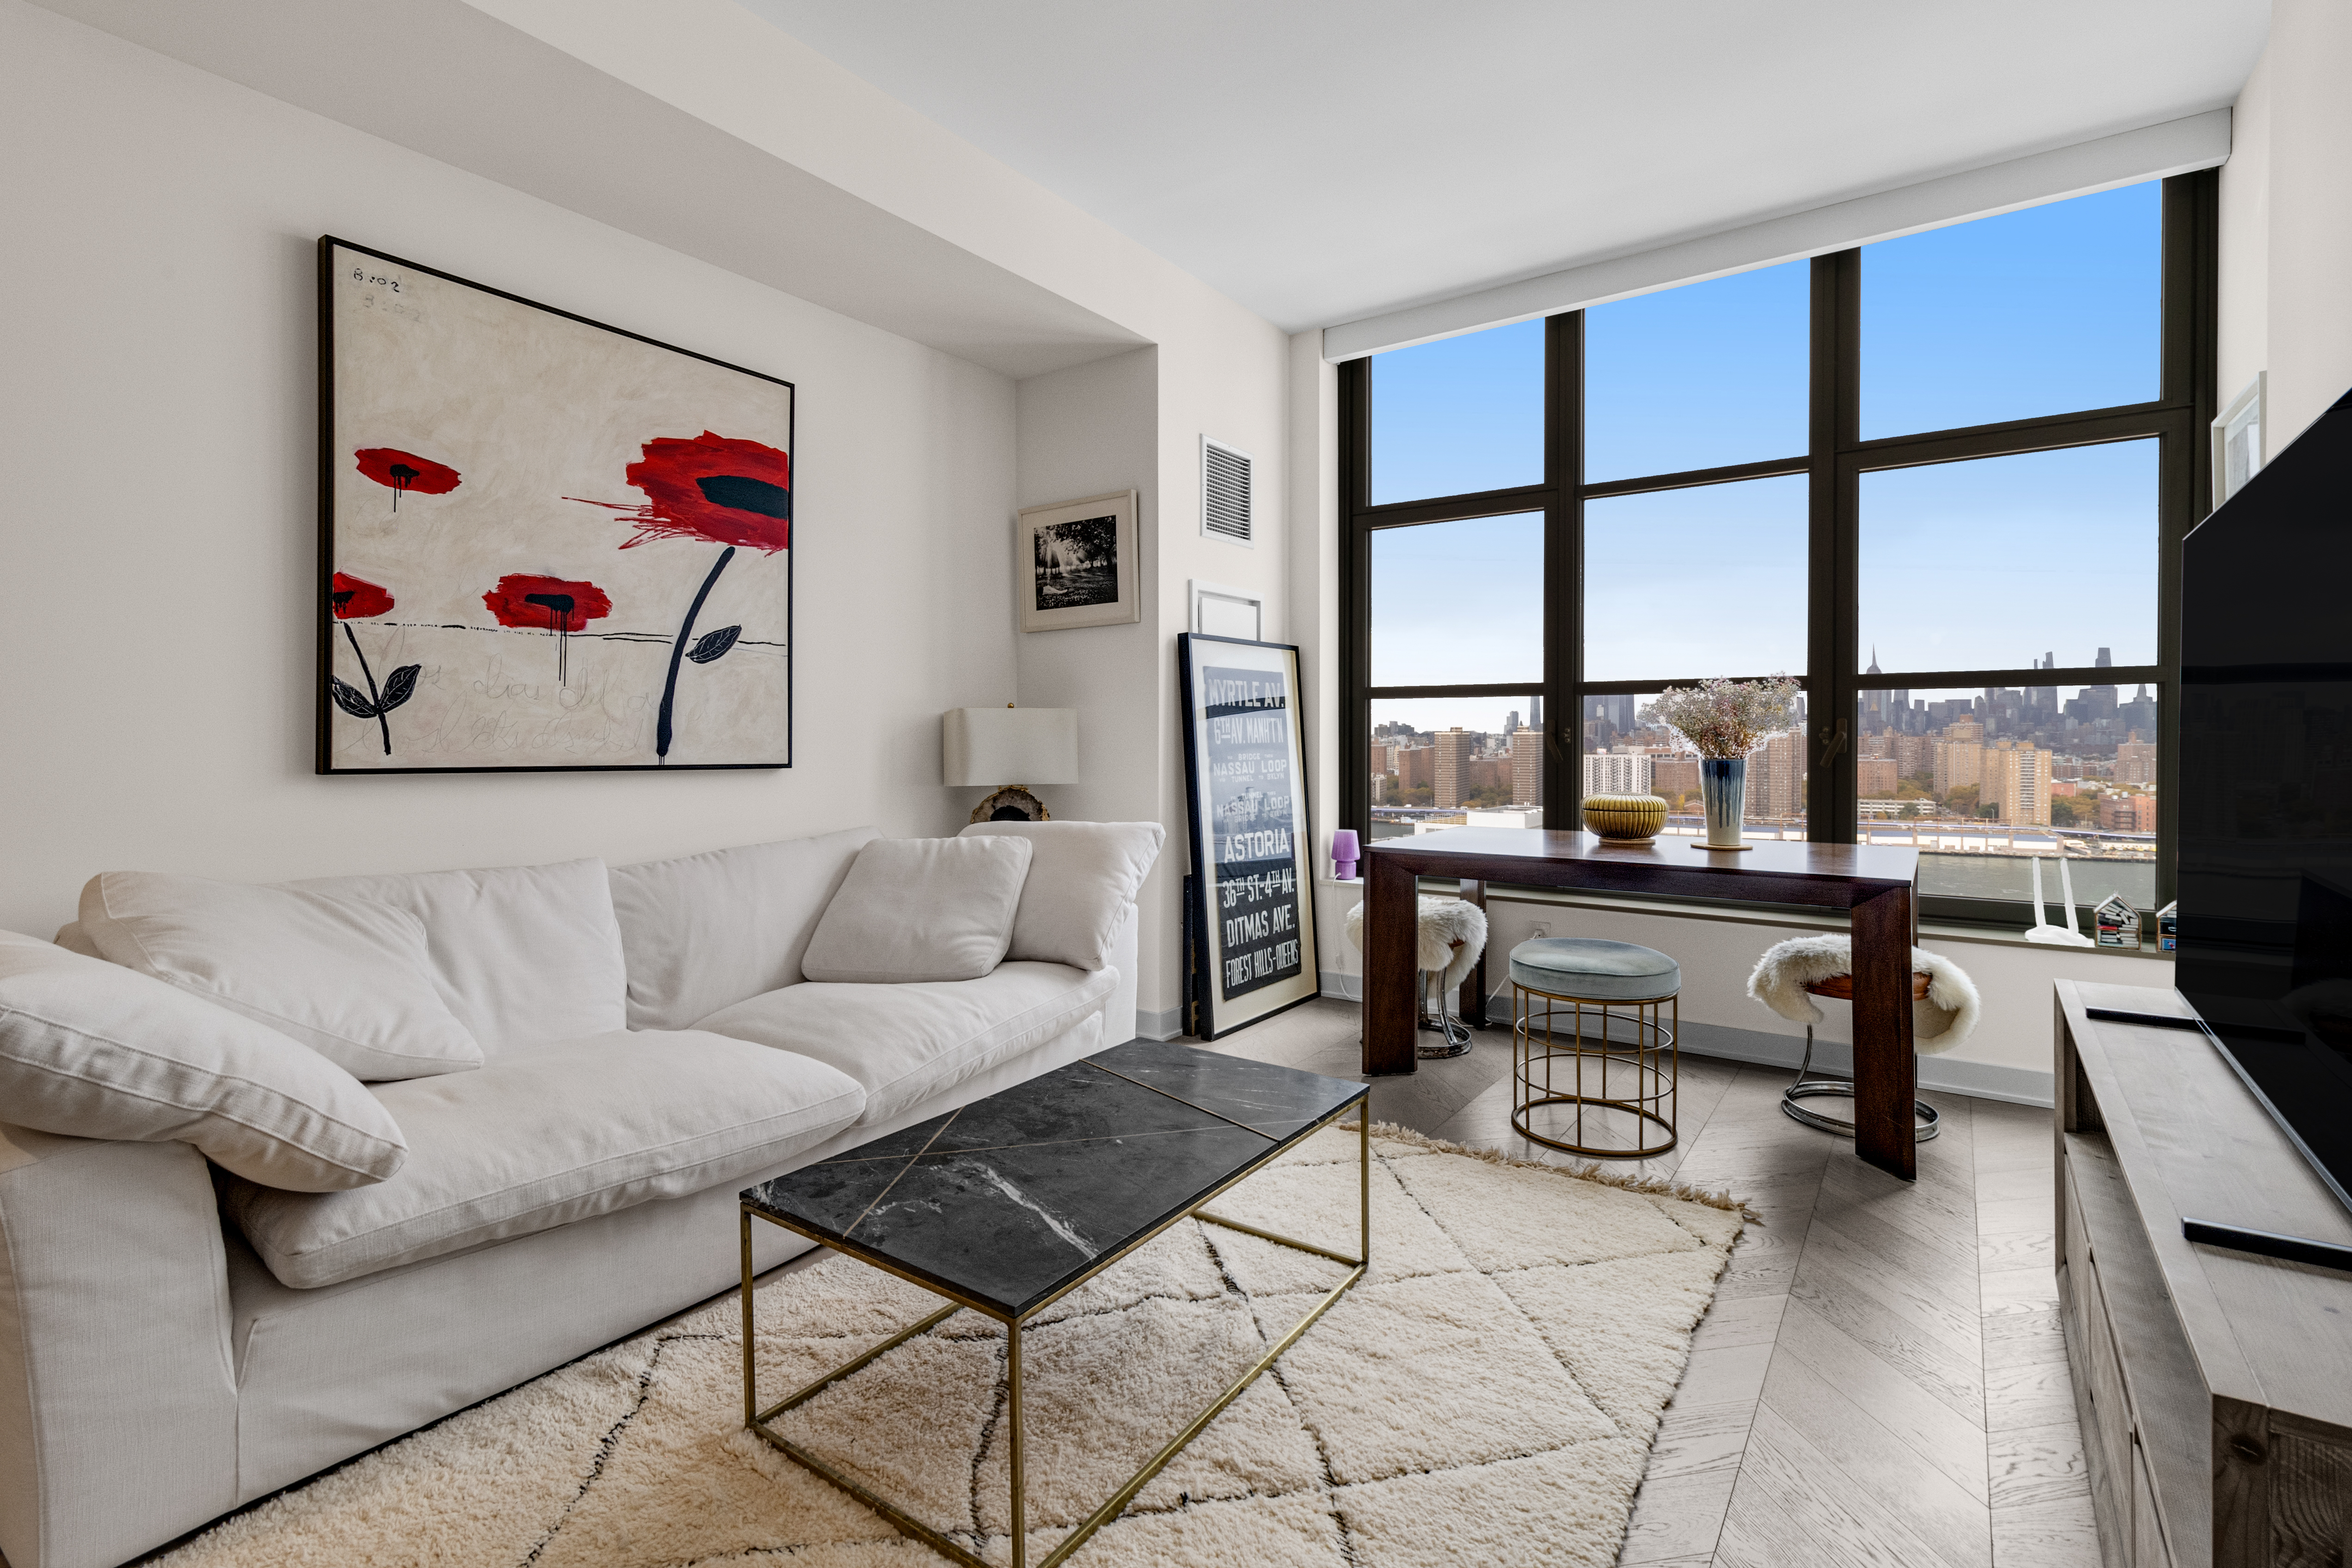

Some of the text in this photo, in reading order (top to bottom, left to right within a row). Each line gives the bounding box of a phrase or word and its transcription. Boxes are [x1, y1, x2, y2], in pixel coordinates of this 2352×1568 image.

[1208, 679, 1284, 707] MYRTLE AV.
[1214, 717, 1231, 744] 6TH
[1231, 717, 1245, 744] AV.
[1213, 759, 1287, 776] NASSAU LOOP
[1217, 796, 1290, 818] NASSAU LOOP
[1241, 791, 1263, 800] TUNNEL
[1234, 814, 1256, 823] BRIDGE
[1224, 828, 1290, 864] ASTORIA
[1223, 877, 1245, 908] 36TH
[1282, 868, 1294, 894] AV.
[1226, 904, 1295, 948] DITMAS AVE.
[1226, 953, 1252, 988] FOREST
